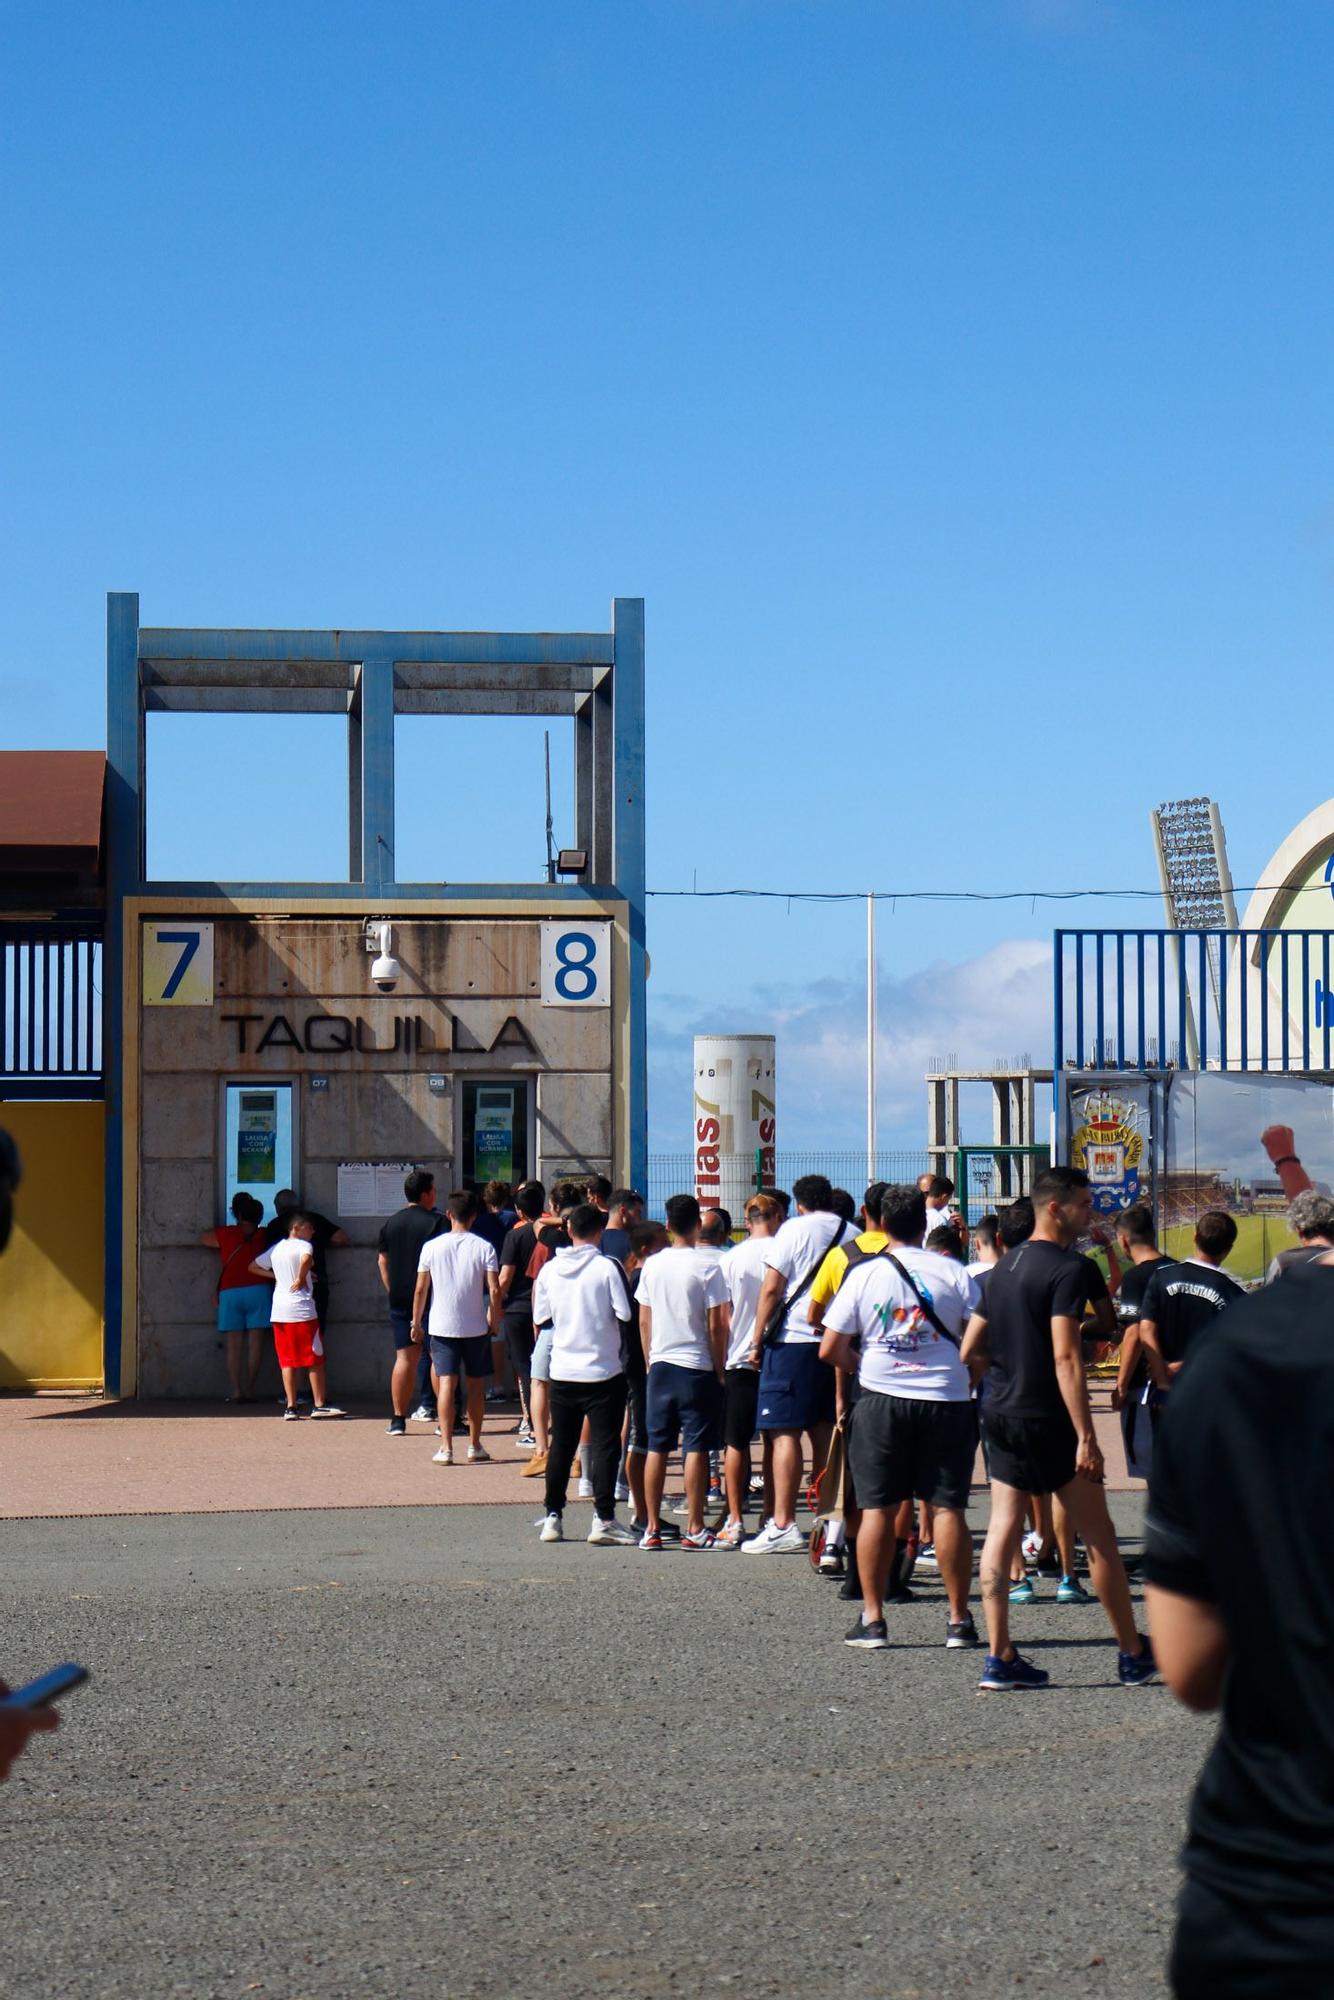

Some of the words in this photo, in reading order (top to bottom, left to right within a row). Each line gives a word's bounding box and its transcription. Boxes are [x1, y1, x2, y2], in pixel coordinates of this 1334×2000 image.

[156, 931, 201, 999] 7
[554, 931, 598, 1001] 8
[220, 1015, 536, 1054] TAQUILLA
[312, 1079, 327, 1087] 07
[429, 1079, 445, 1087] 08
